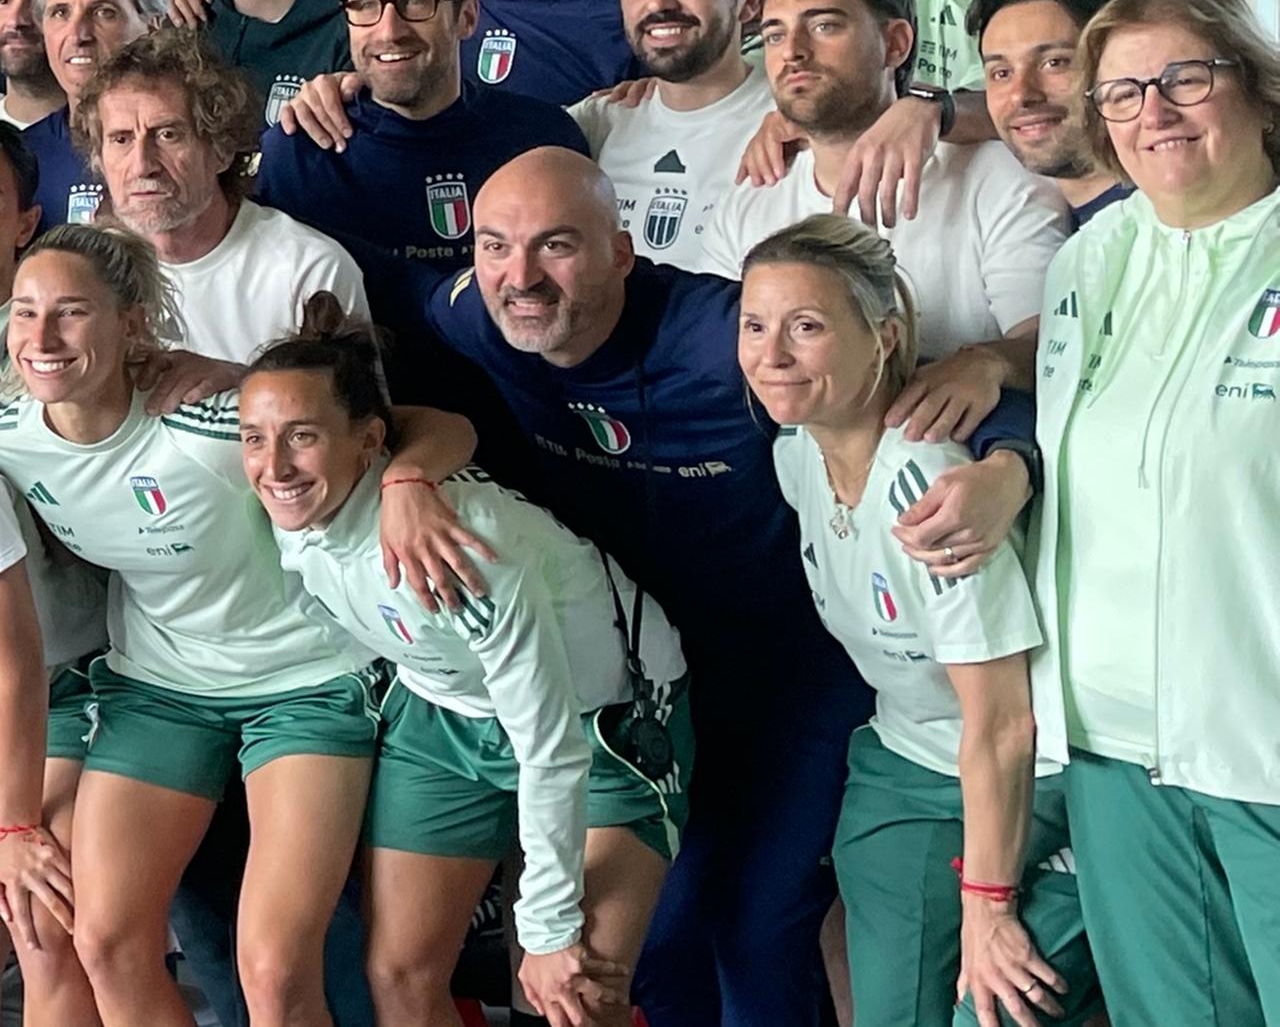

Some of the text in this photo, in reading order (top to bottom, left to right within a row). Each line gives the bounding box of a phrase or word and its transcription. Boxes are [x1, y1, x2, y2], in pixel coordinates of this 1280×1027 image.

[429, 186, 463, 200] ITALIA
[651, 201, 682, 212] ITALIA
[405, 245, 454, 259] Poste
[1215, 383, 1249, 399] eni
[677, 463, 707, 478] eni
[146, 543, 172, 556] eni
